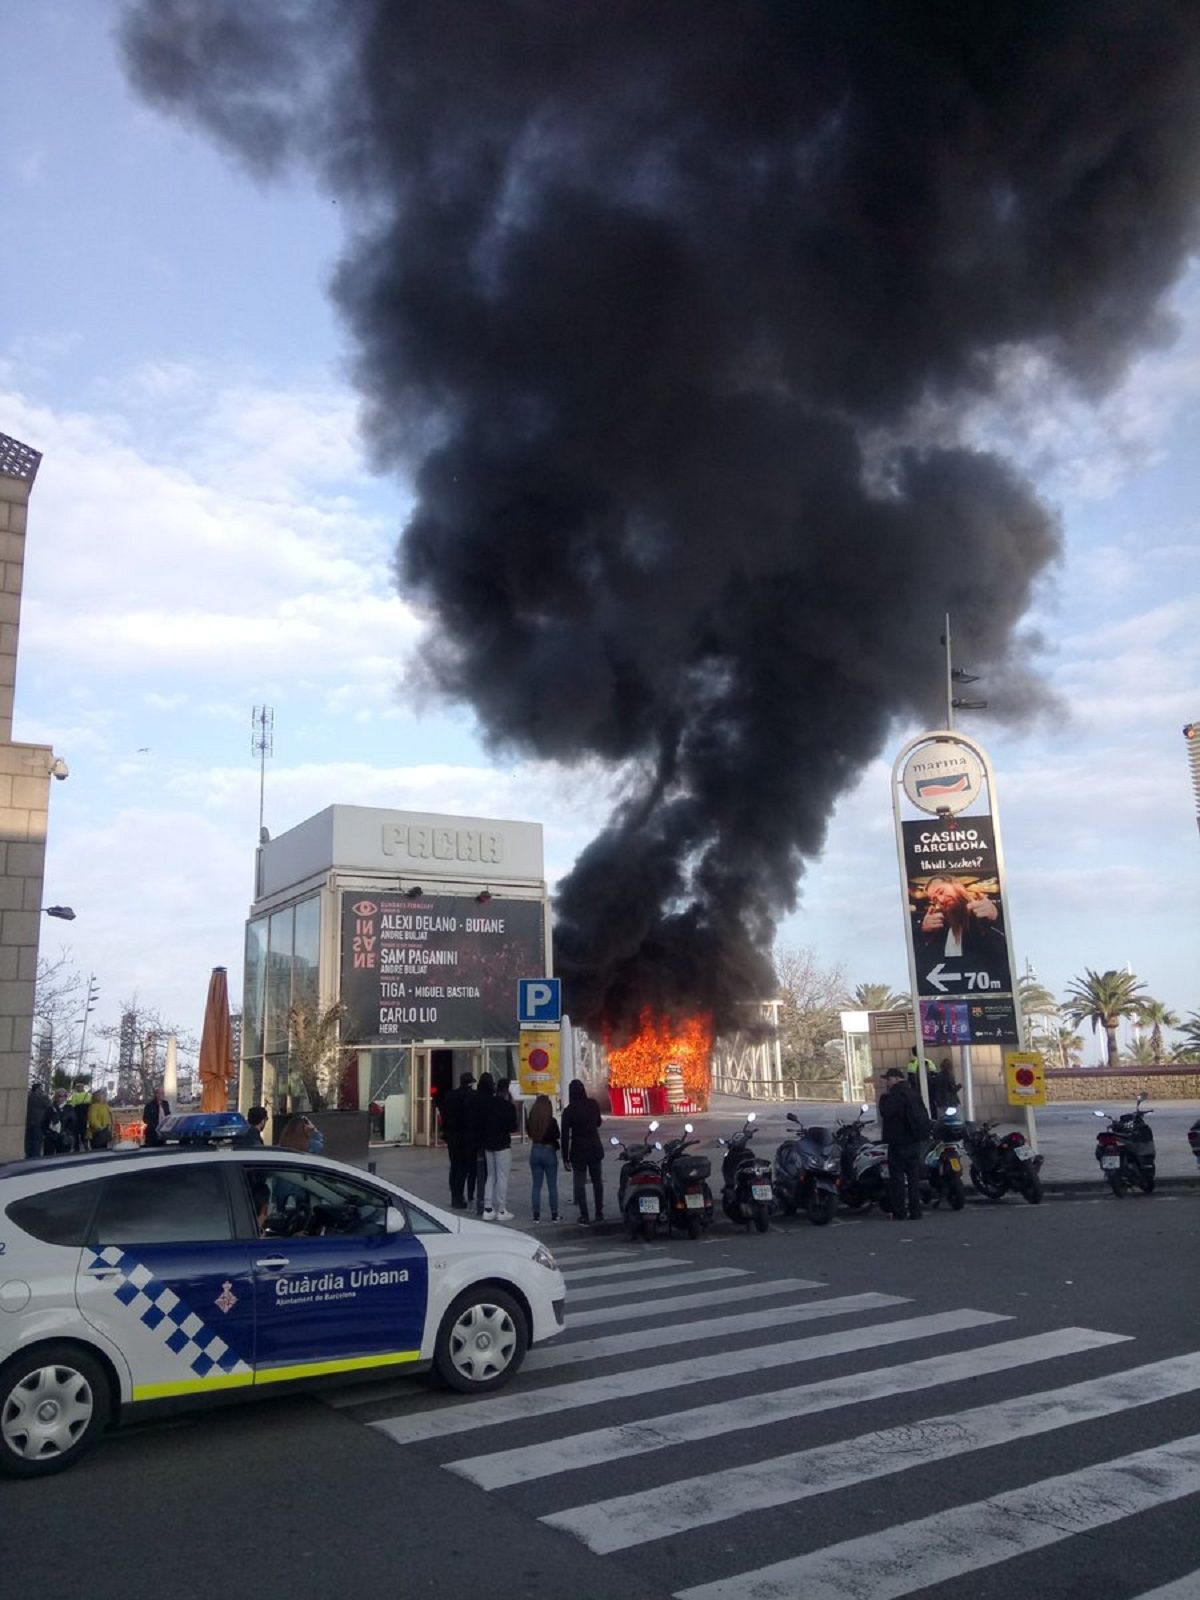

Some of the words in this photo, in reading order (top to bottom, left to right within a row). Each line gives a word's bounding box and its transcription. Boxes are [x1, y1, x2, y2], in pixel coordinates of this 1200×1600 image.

[913, 757, 967, 773] marina
[920, 830, 978, 844] CASINO
[914, 840, 988, 854] BARCELONA
[381, 915, 412, 930] ALEXI
[416, 917, 457, 932] DELANO
[466, 918, 505, 934] BUTANE
[380, 931, 403, 941] ANDRE
[381, 949, 405, 965] SAM
[409, 950, 458, 966] PAGANINI
[964, 972, 1001, 990] 70m
[380, 983, 405, 998] TIGA
[415, 986, 445, 998] MIGUEL
[447, 987, 480, 998] BASTIDA
[526, 983, 552, 1017] P
[379, 1008, 417, 1023] CARLO
[420, 1008, 437, 1023] LIO
[379, 1024, 398, 1034] HERR
[275, 1273, 344, 1296] Guàrdia
[351, 1268, 409, 1288] Urbana
[275, 1296, 313, 1307] Ajuntament
[315, 1294, 323, 1302] de
[324, 1291, 357, 1302] Barcelona
